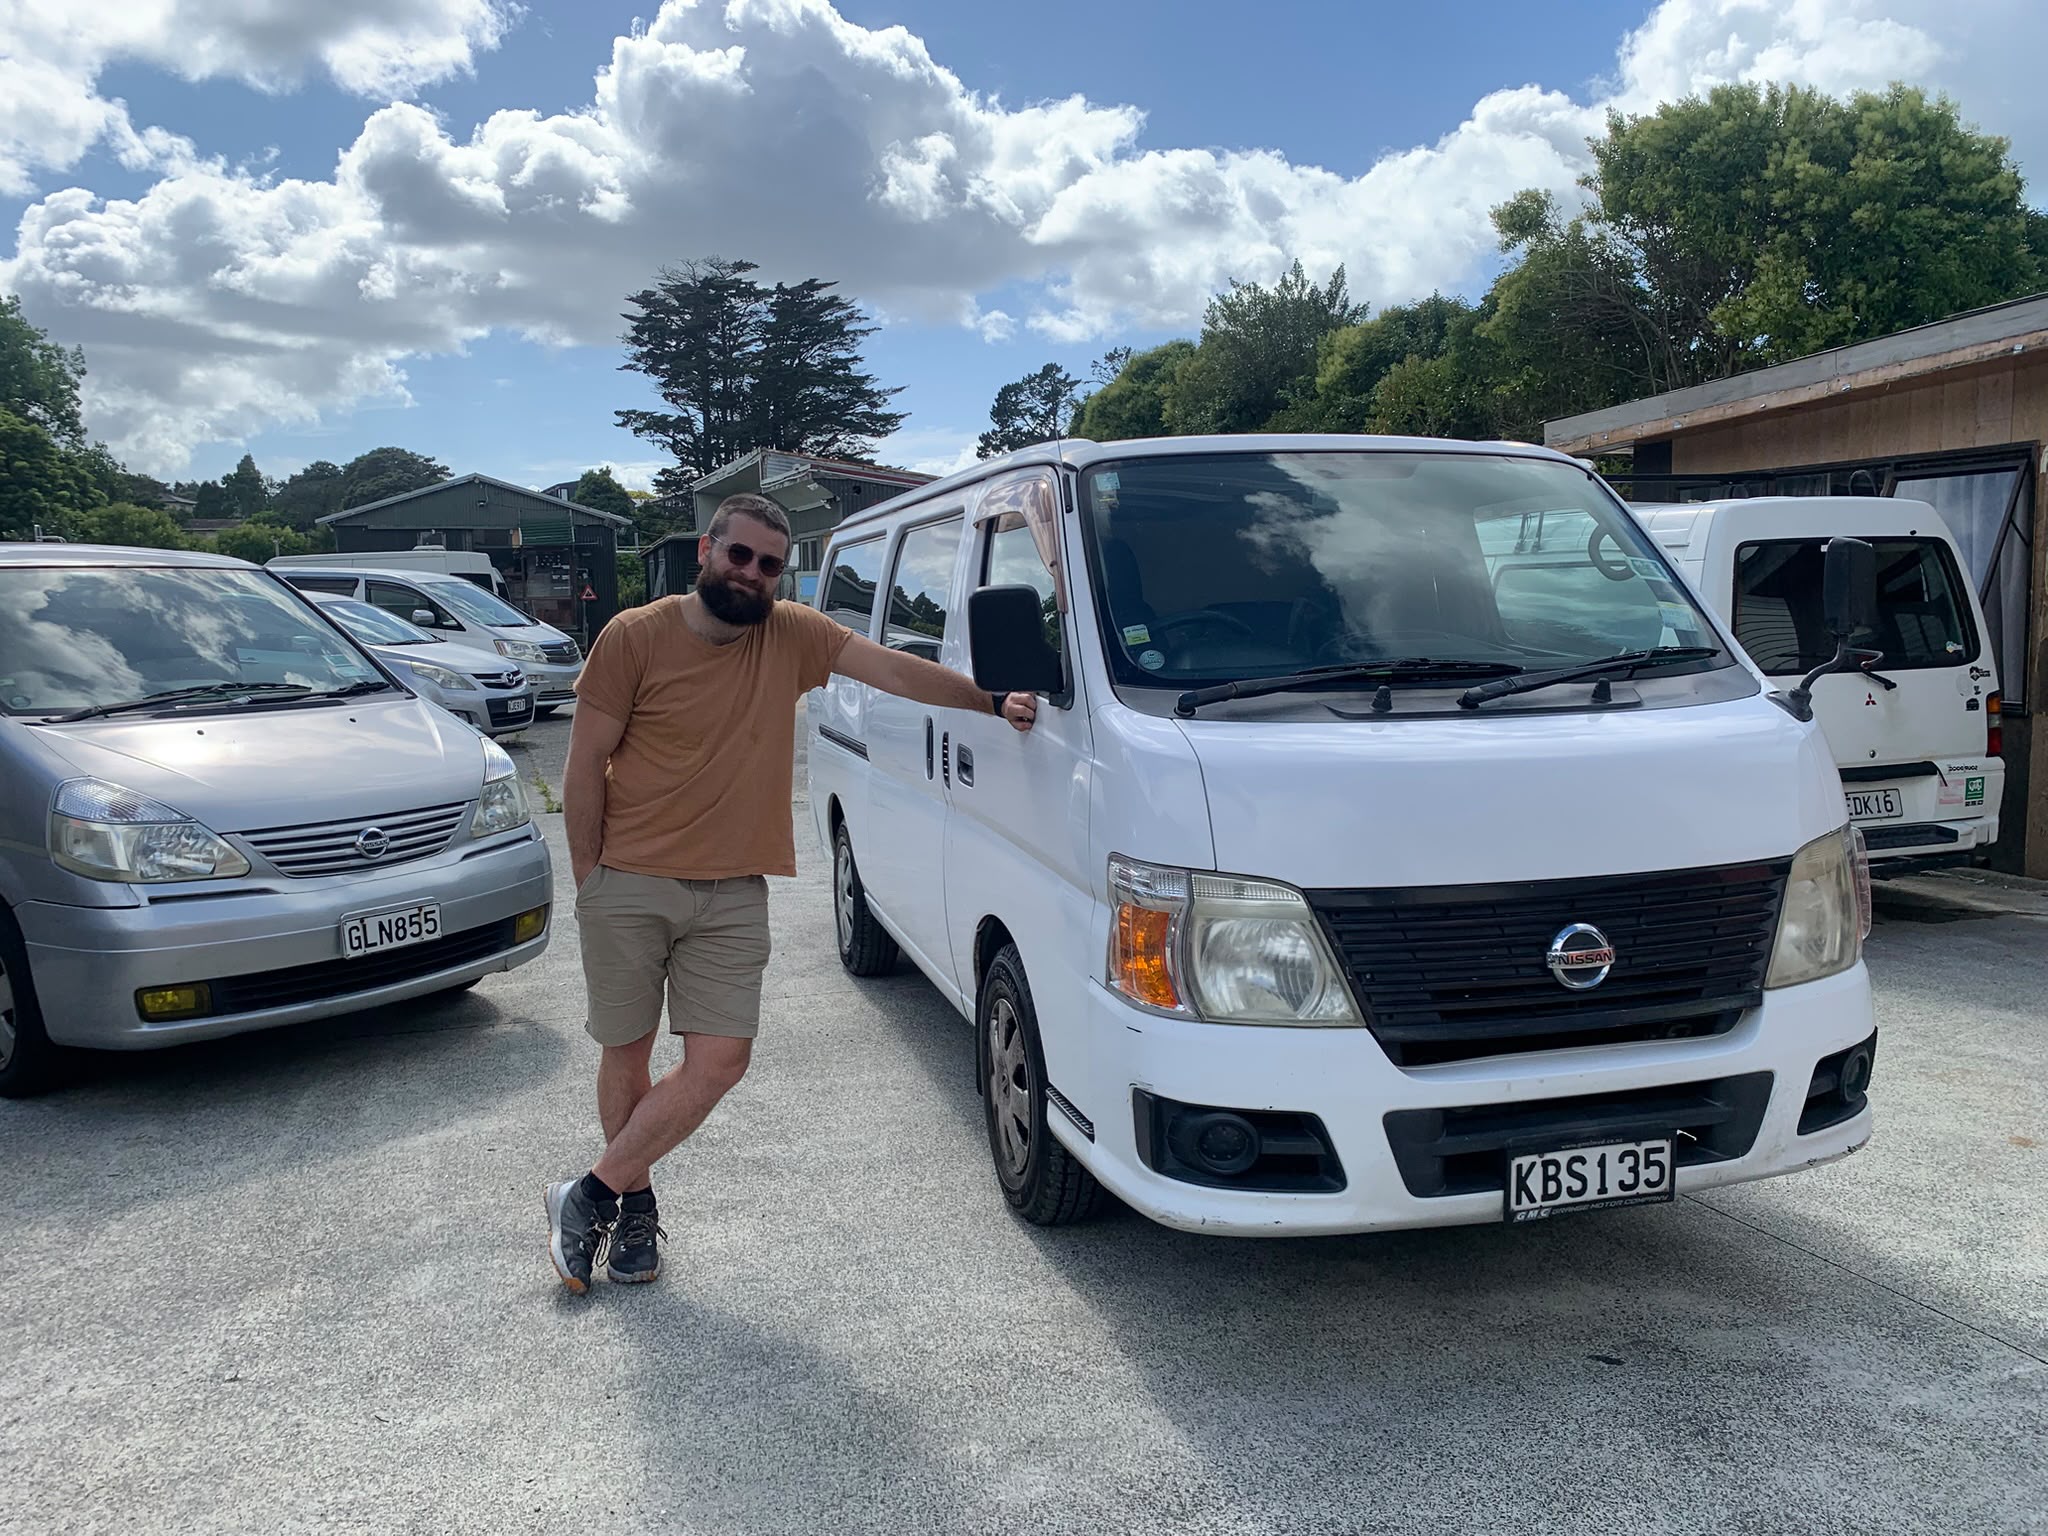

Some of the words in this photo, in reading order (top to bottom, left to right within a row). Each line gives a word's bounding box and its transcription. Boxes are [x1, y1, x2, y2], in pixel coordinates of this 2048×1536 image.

[361, 839, 388, 850] NISSAN
[348, 910, 438, 951] GLN855
[1558, 950, 1612, 965] NISSAN
[1515, 1146, 1666, 1206] KBS135
[1516, 1207, 1550, 1221] GMC
[1590, 1200, 1623, 1209] MOTOR
[1624, 1195, 1669, 1205] COMPANY
